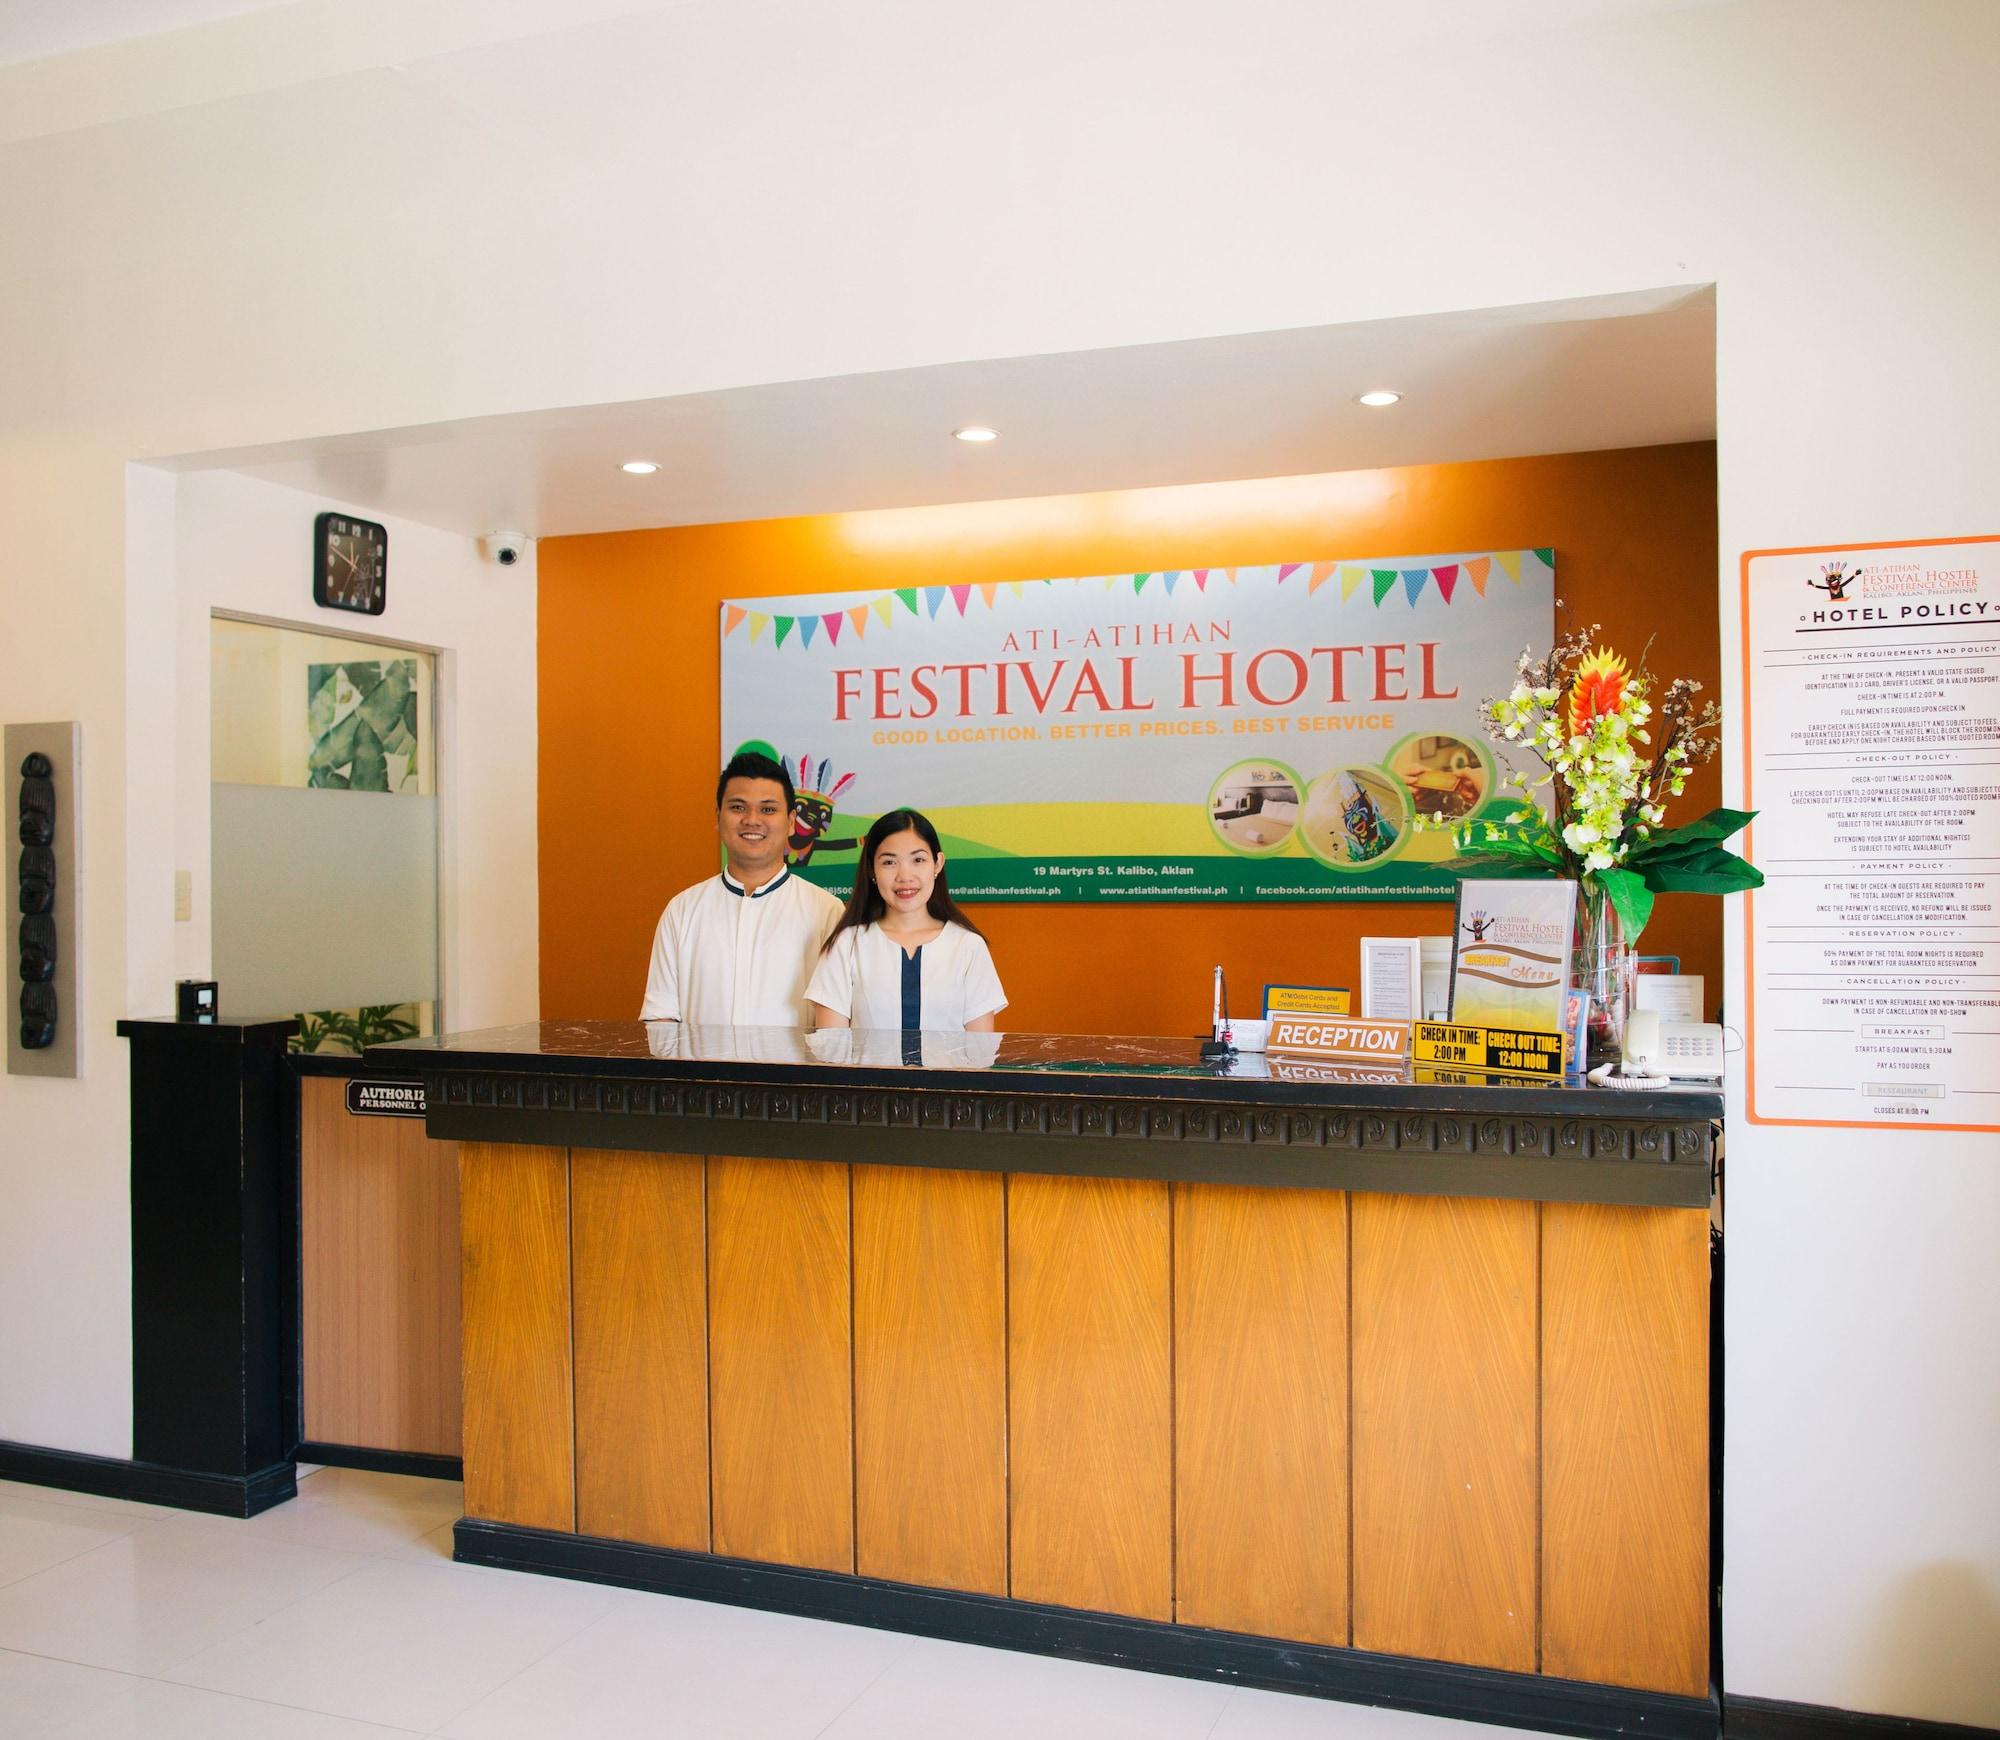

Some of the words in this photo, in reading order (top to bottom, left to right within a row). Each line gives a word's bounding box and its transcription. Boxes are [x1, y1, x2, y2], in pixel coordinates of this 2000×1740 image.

[1863, 573, 1920, 585] FESTIVAL
[1926, 570, 1979, 581] HOSTEL
[1873, 581, 1936, 592] CONFERENCE
[1940, 579, 1978, 588] CENTER
[1928, 588, 1978, 596] PHILIPPINES
[1813, 607, 1888, 623] HOTEL
[1901, 602, 1988, 618] POLICY
[1002, 620, 1231, 652] ATI-ATIHAN
[1857, 649, 1932, 658] REQUIREMENTS
[1964, 667, 1985, 675] ISSUED
[832, 656, 1155, 721] FESTIVAL
[1177, 642, 1459, 708] HOTEL
[873, 729, 928, 745] GOOD
[936, 727, 1042, 743] LOCATION.
[1050, 722, 1131, 740] BETTER
[1140, 719, 1225, 737] PRICES.
[1232, 717, 1289, 734] BEST
[1298, 714, 1395, 732] SERVICE
[1033, 866, 1046, 876] 19
[1049, 866, 1094, 877] Martyrs
[1097, 866, 1113, 876] St.
[1116, 865, 1158, 877] Kalibo,
[1160, 865, 1194, 876] Aklan
[948, 886, 1061, 896] ns@atiatihanfestival.ph
[1100, 885, 1228, 896] www.atiatihanfestival.ph
[1255, 885, 1455, 895] facebook.com/atiatihanfestivalhotel
[1495, 922, 1529, 931] FESTIVAL
[1533, 923, 1565, 933] HOSTEL
[1511, 966, 1554, 980] Menu
[1276, 1024, 1400, 1051] RECEPTION
[1421, 1026, 1447, 1043] CHECK
[1448, 1028, 1457, 1043] IN
[1459, 1029, 1481, 1045] TIME:
[1488, 1031, 1516, 1050] CHECK
[1517, 1034, 1535, 1051] OUT
[1434, 1045, 1452, 1060] 2:00
[1454, 1047, 1466, 1061] PM
[1498, 1051, 1522, 1068] 12:00
[1524, 1052, 1549, 1070] NOON
[359, 1087, 425, 1101] AUTHORIZ
[359, 1099, 417, 1109] PERSONNEL
